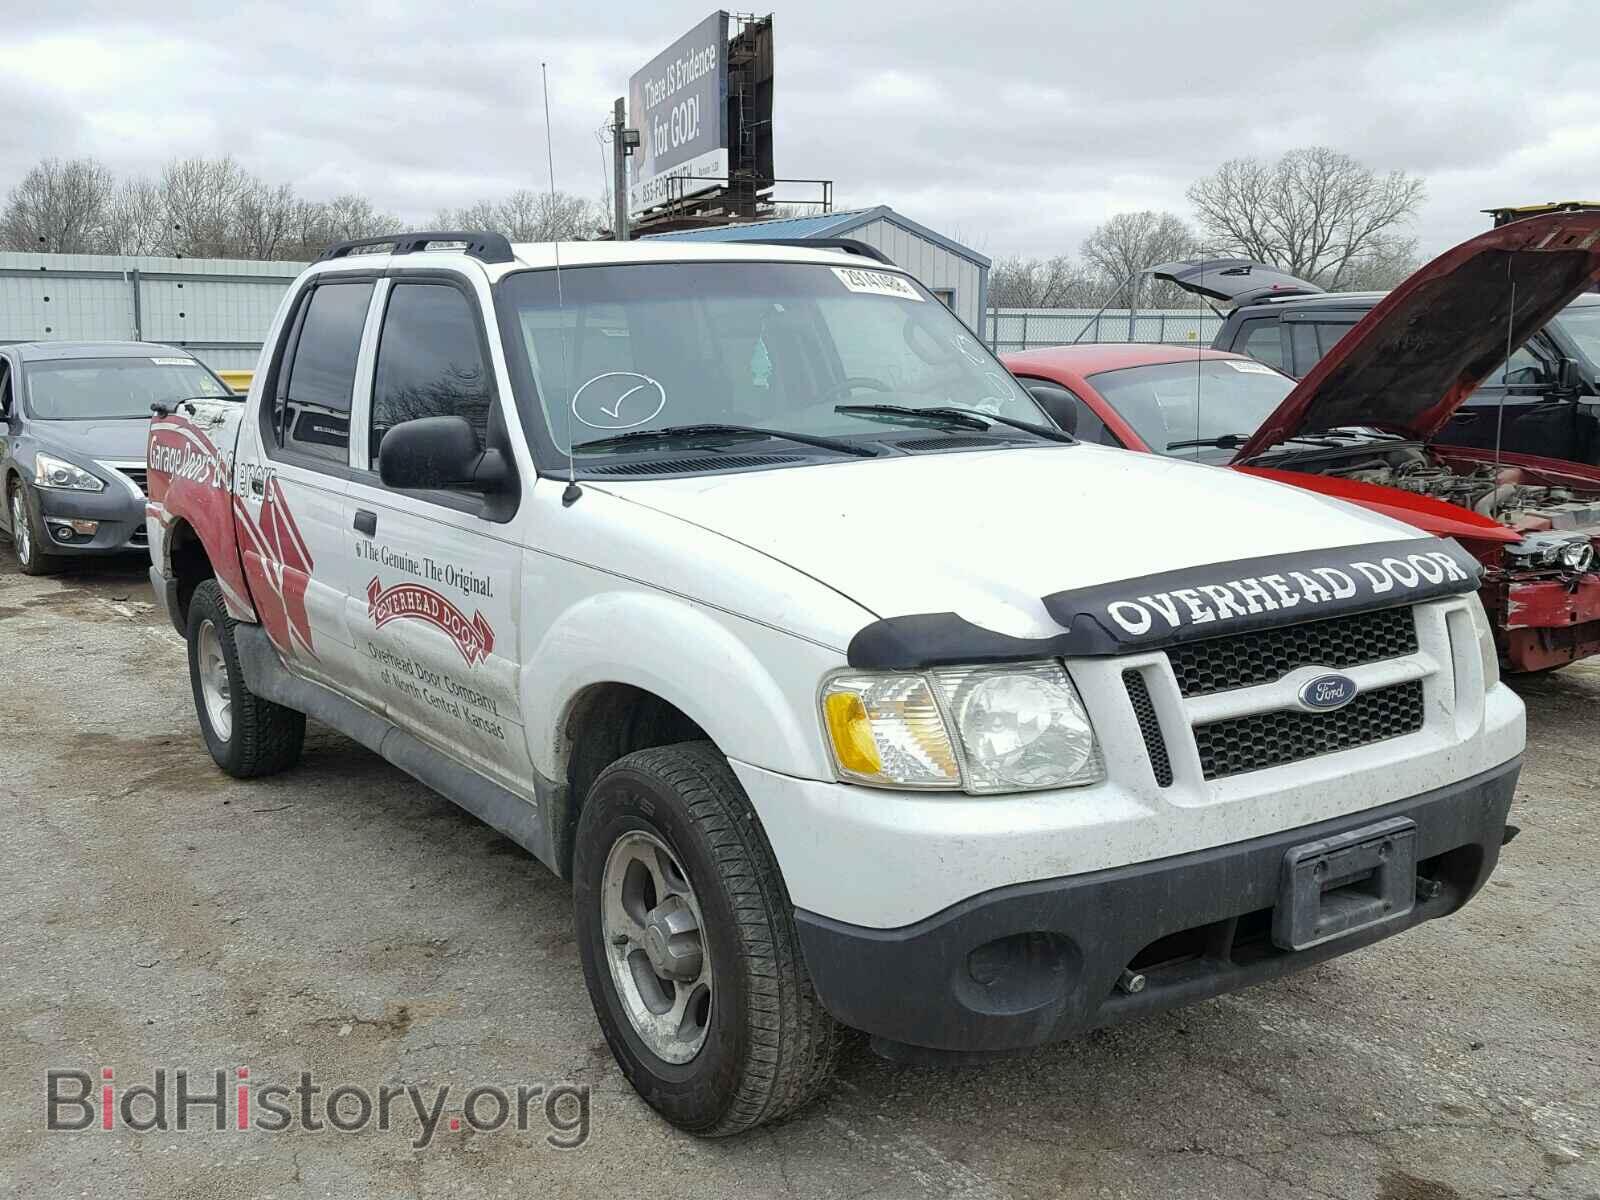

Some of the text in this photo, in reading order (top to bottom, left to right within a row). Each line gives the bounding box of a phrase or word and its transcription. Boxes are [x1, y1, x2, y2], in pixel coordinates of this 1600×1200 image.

[644, 80, 667, 111] There
[676, 44, 716, 91] Evidence
[654, 94, 700, 157] for GOD!
[150, 435, 182, 482] Garage
[181, 441, 211, 483] Doors
[212, 449, 225, 488] &
[362, 540, 494, 598] The Genuine. The Original.
[1107, 551, 1468, 636] OVERHEAD DOOR
[376, 591, 480, 652] OVERHEAD DOOR
[368, 642, 497, 716] Overhead Door Company
[381, 670, 505, 740] of North Central Kansas
[1315, 681, 1344, 701] Ford
